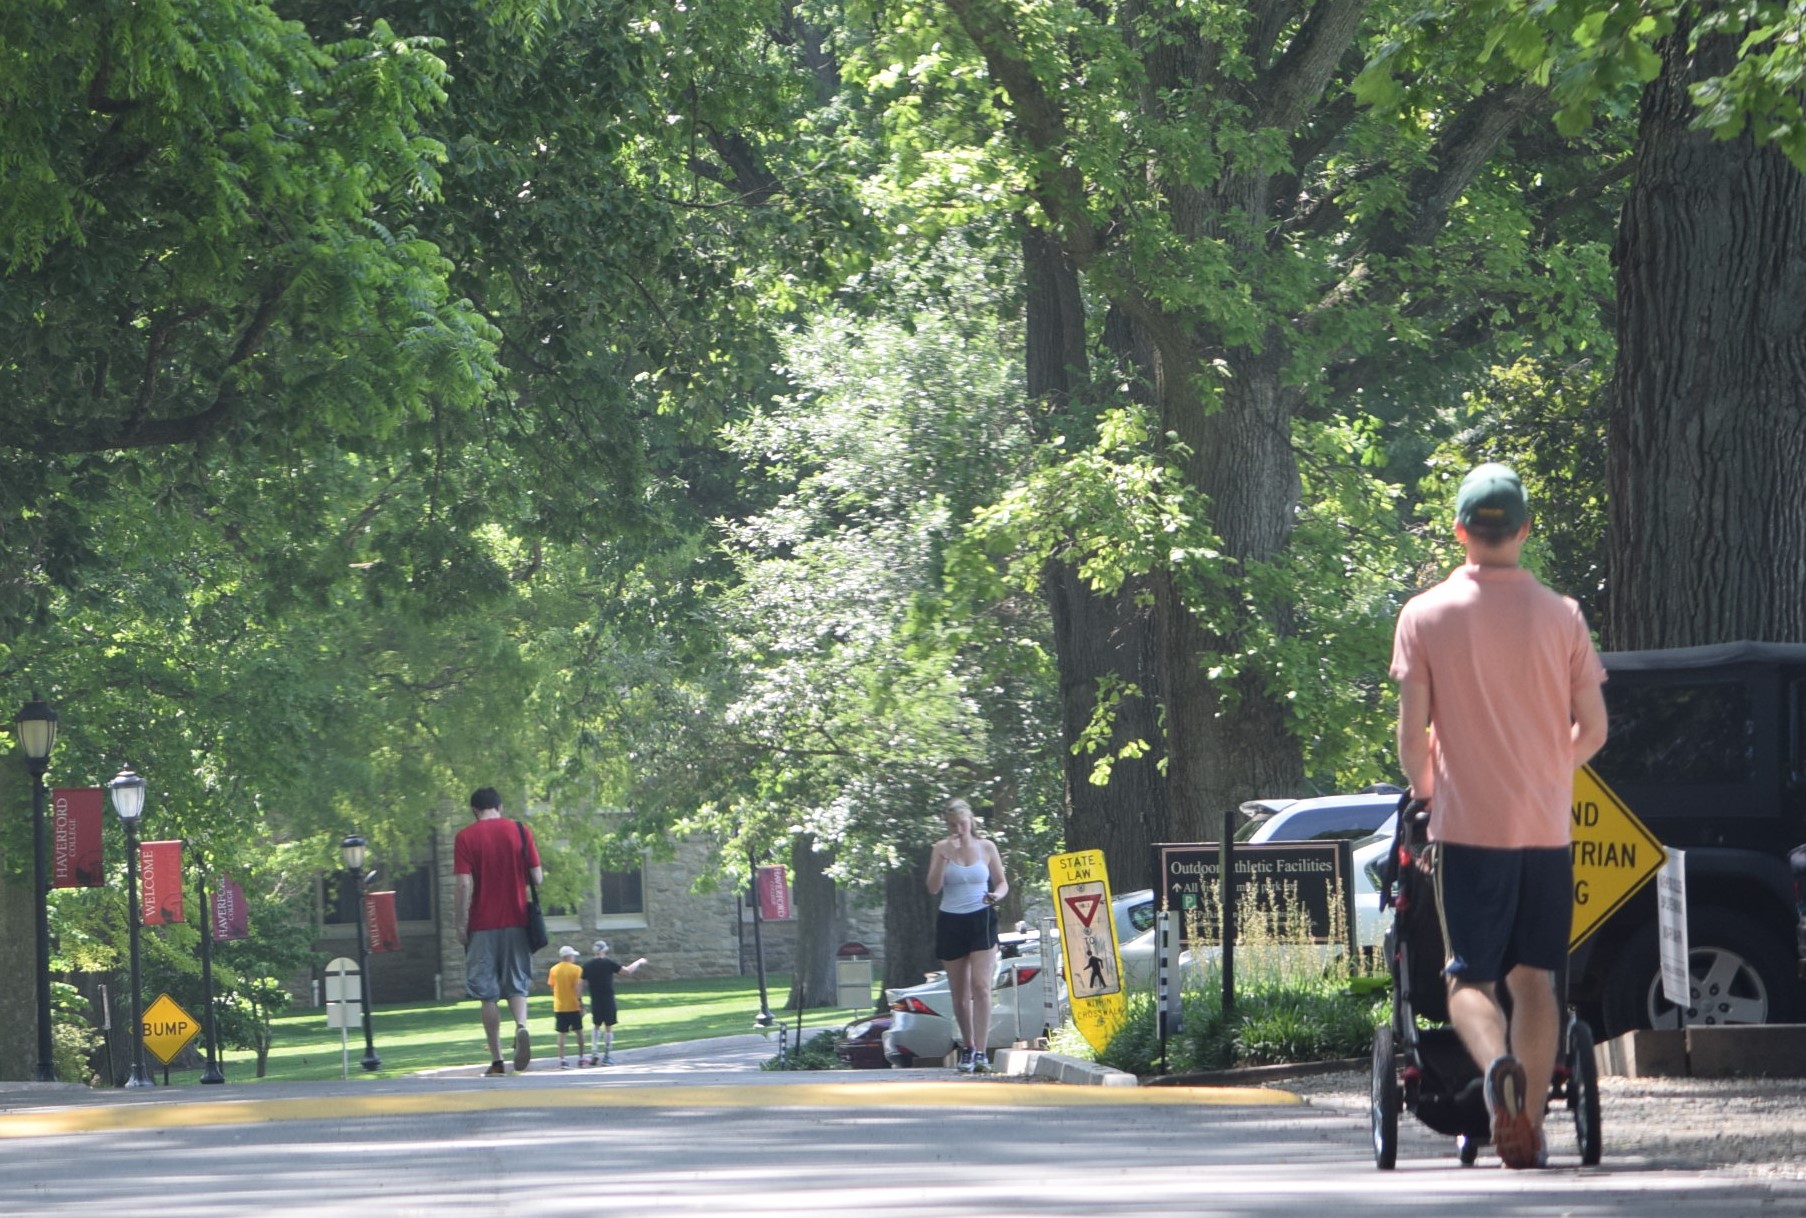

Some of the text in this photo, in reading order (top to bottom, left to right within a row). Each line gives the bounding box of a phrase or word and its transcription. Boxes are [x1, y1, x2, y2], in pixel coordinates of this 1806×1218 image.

[56, 798, 68, 878] HAVERFORD
[69, 818, 77, 857] COLLEGE
[1060, 855, 1095, 869] STATE
[1233, 859, 1273, 873] thletic
[1276, 858, 1332, 872] Facilities
[1067, 869, 1091, 881] LAW
[143, 850, 155, 917] WELCOME
[1183, 882, 1198, 893] All
[774, 867, 785, 918] HAVERFORD
[142, 1021, 188, 1037] BUMP
